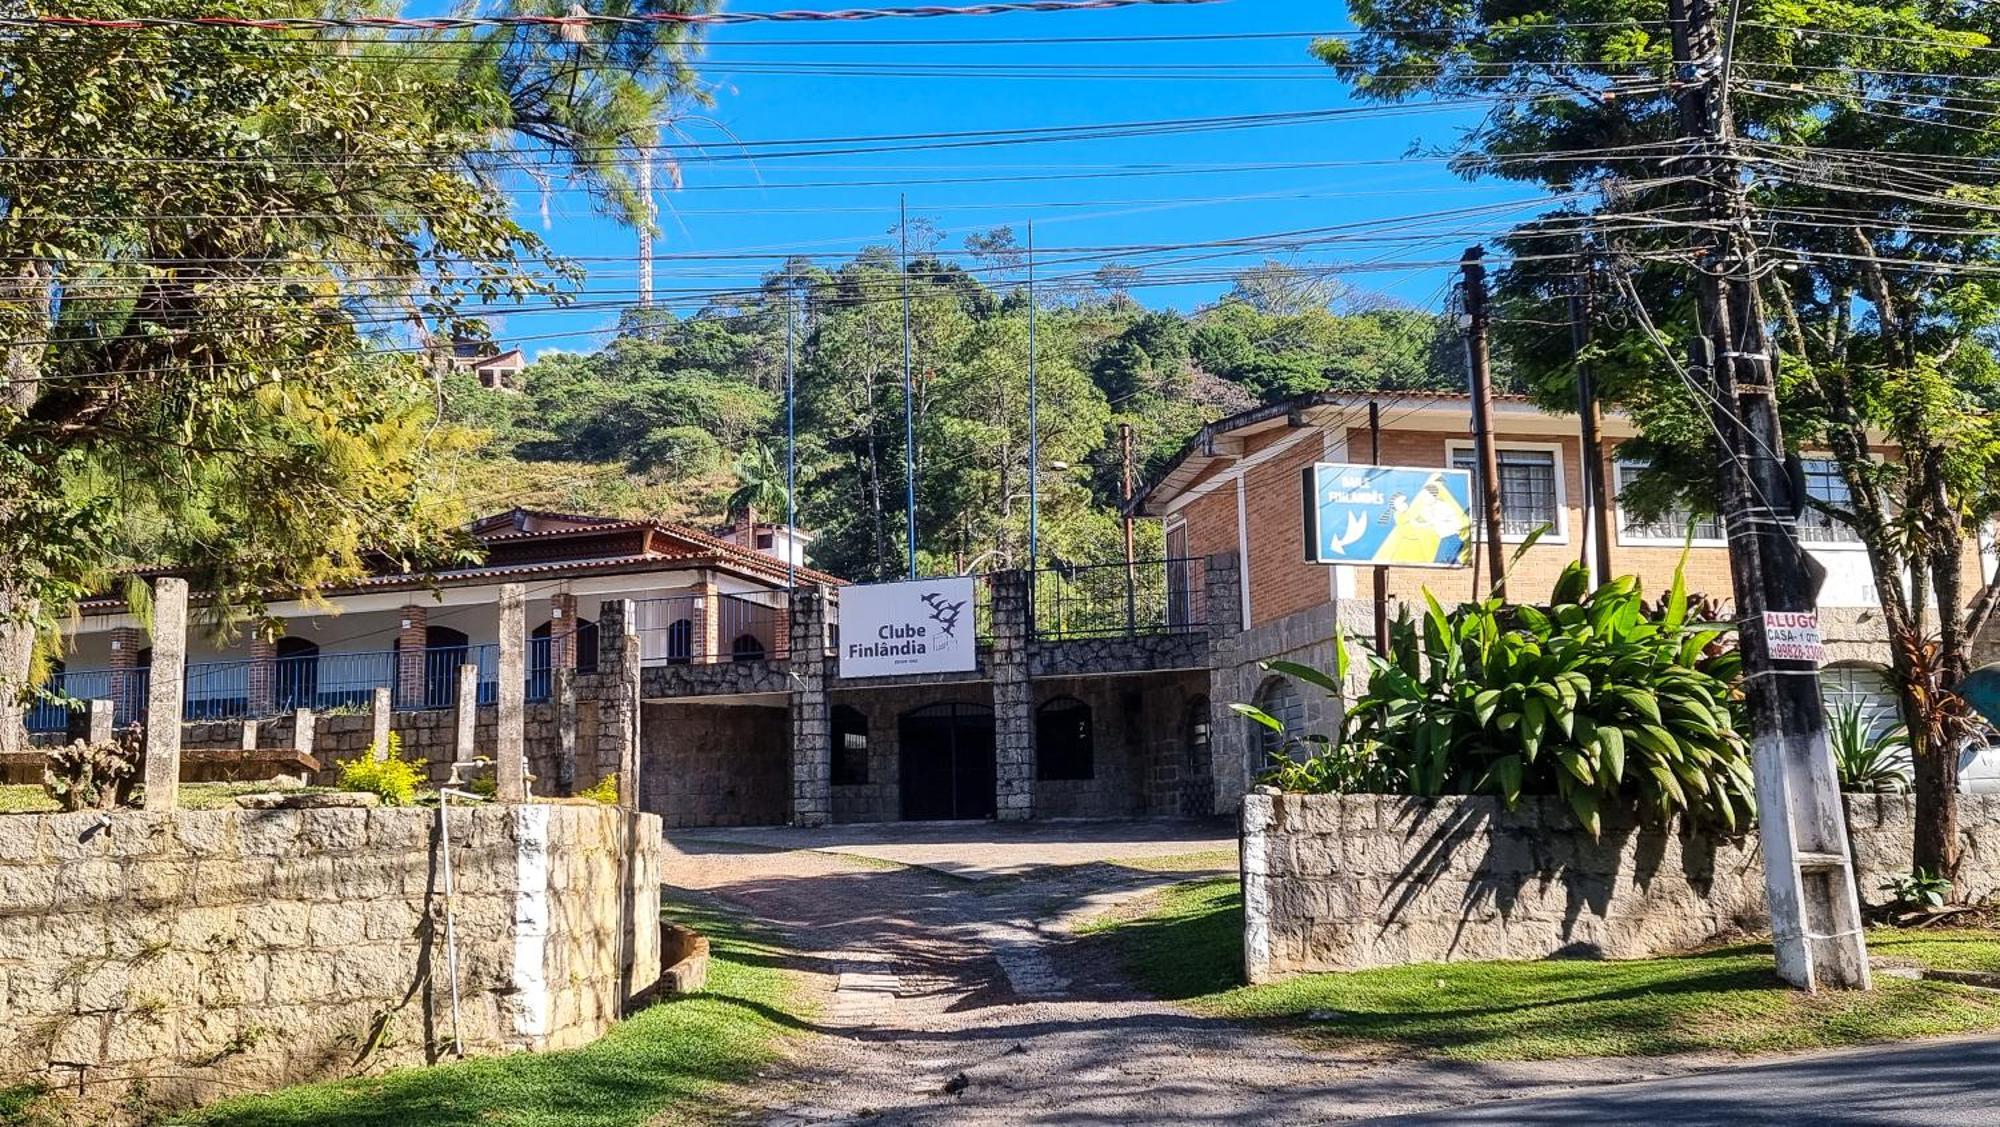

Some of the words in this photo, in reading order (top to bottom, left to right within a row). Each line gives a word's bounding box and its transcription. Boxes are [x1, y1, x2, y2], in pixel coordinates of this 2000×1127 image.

[1766, 613, 1817, 629] ALUGO
[878, 624, 926, 639] Clube
[849, 640, 926, 658] Finlândia
